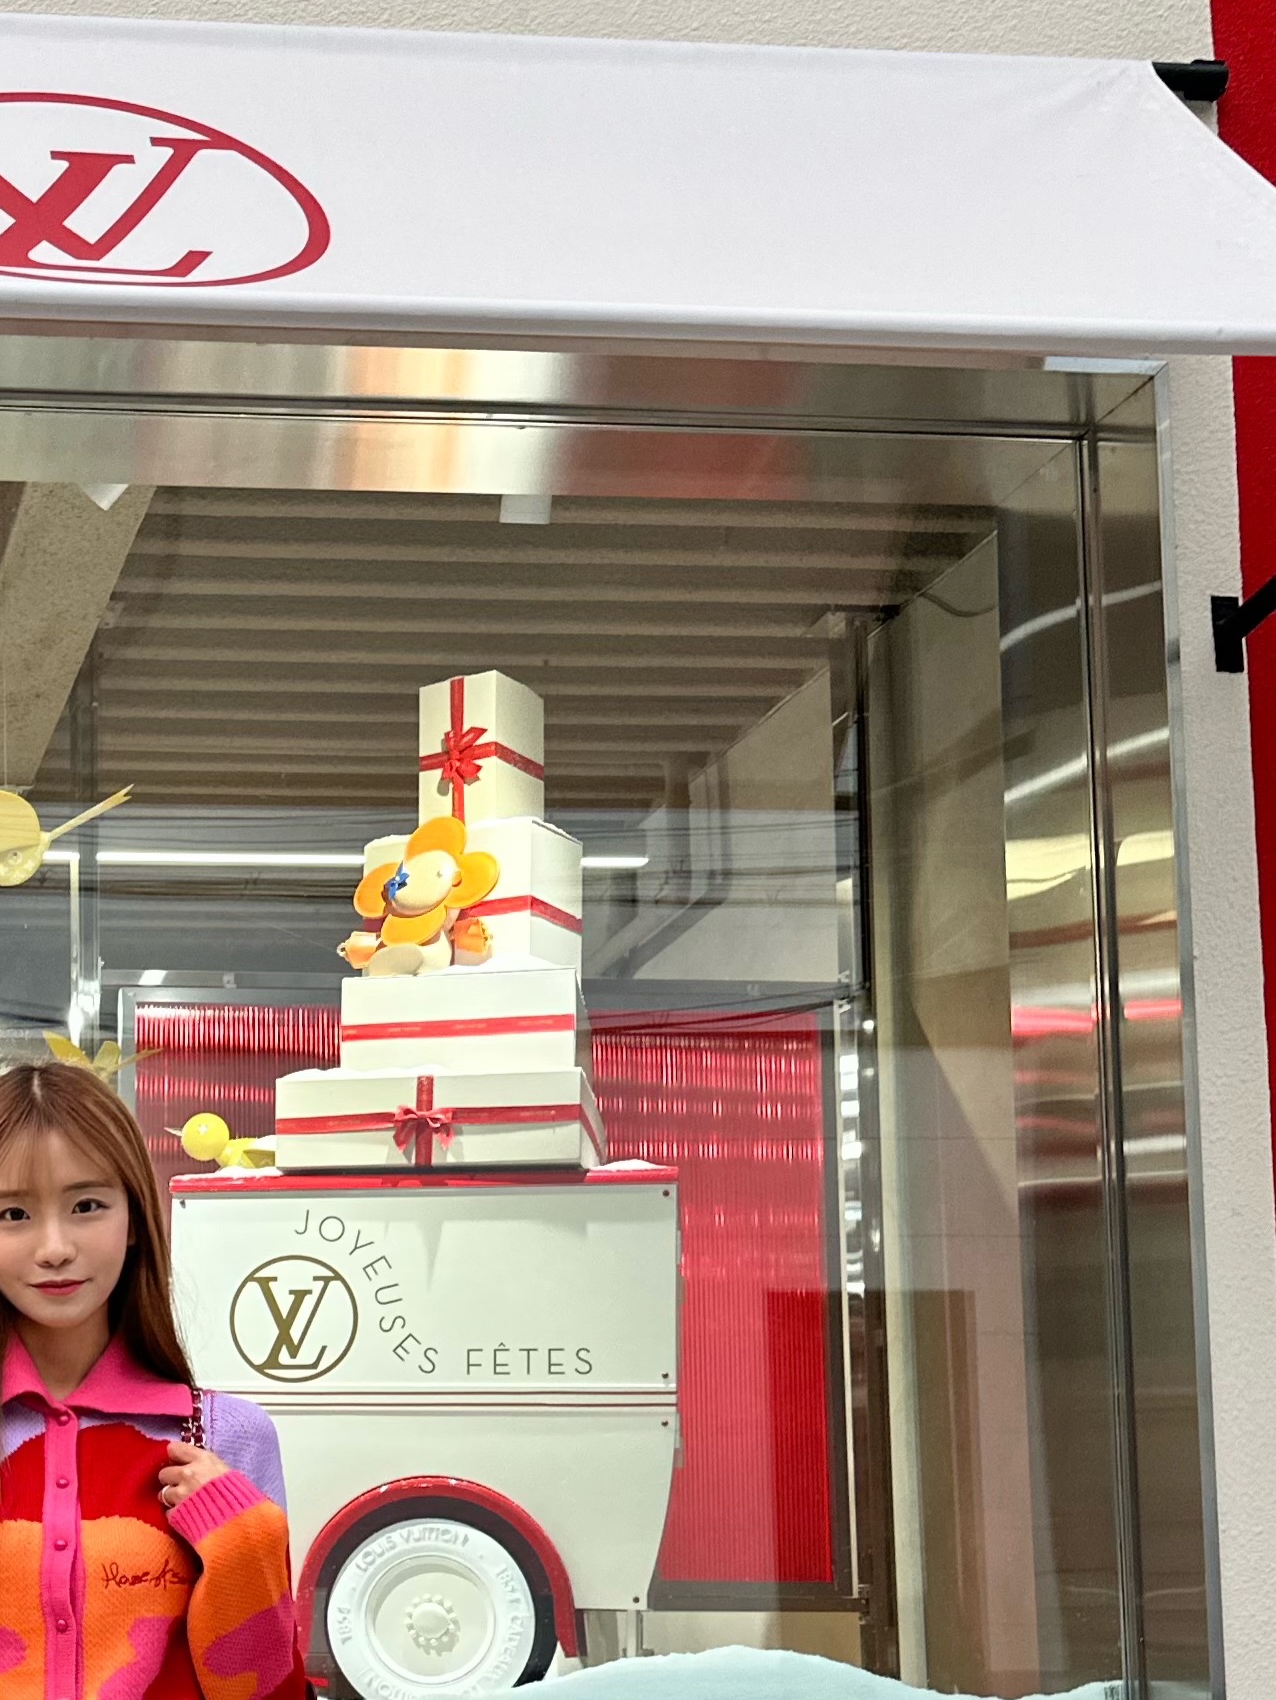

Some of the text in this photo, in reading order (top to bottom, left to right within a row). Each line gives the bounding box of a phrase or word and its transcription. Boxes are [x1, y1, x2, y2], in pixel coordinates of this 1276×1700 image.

[294, 1209, 593, 1376] JOYEUSES FÊTES
[355, 1535, 397, 1573] LOUIS
